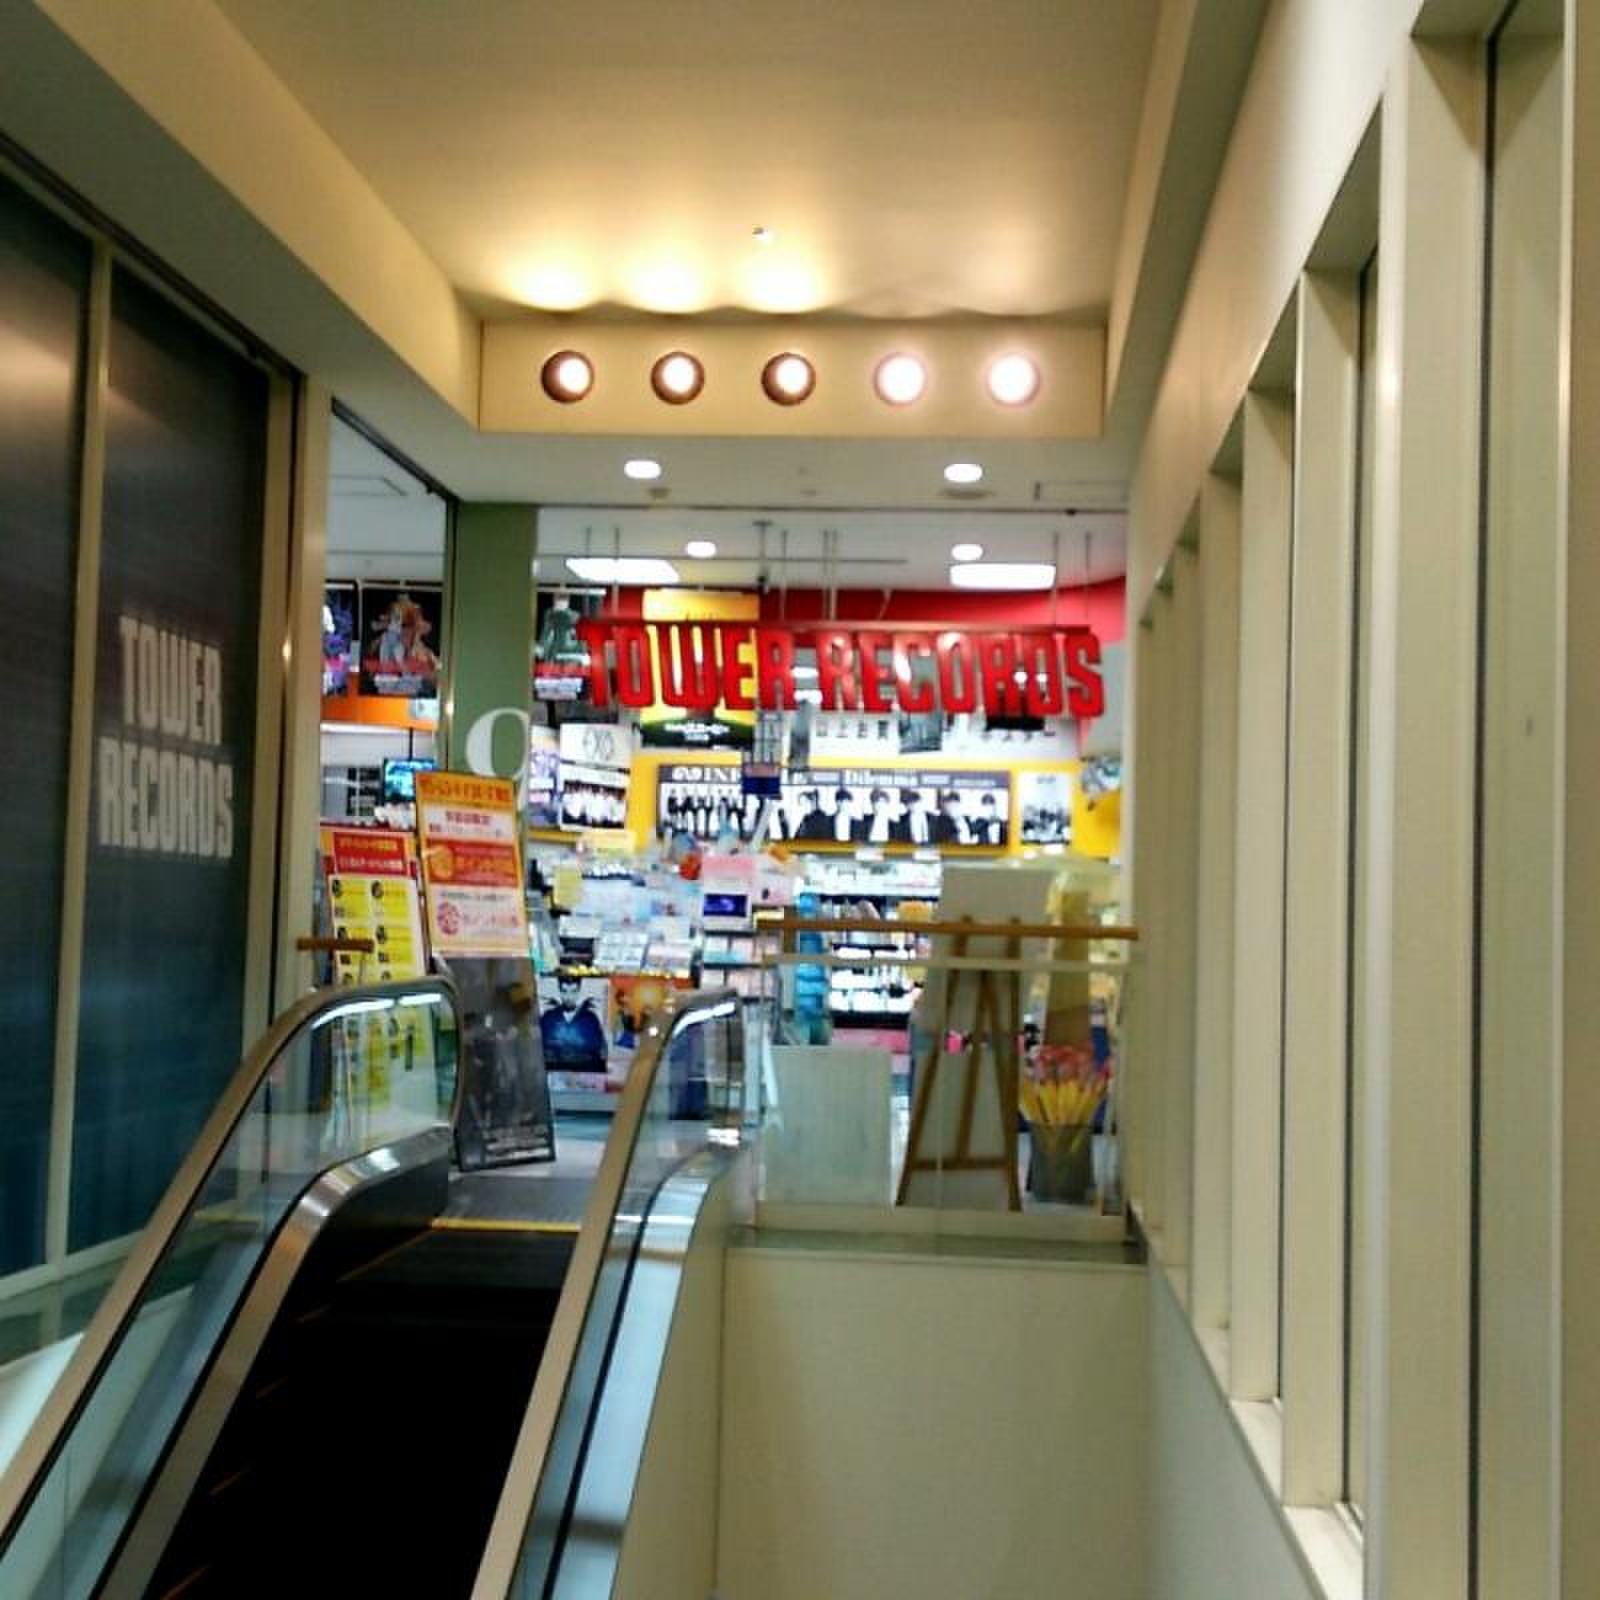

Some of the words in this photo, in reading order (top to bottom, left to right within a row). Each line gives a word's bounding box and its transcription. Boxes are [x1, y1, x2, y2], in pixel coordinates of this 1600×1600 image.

[119, 615, 222, 746] TOWER
[577, 621, 795, 712] TOWER
[817, 625, 1105, 719] RECORDS
[98, 735, 233, 859] RECORDS
